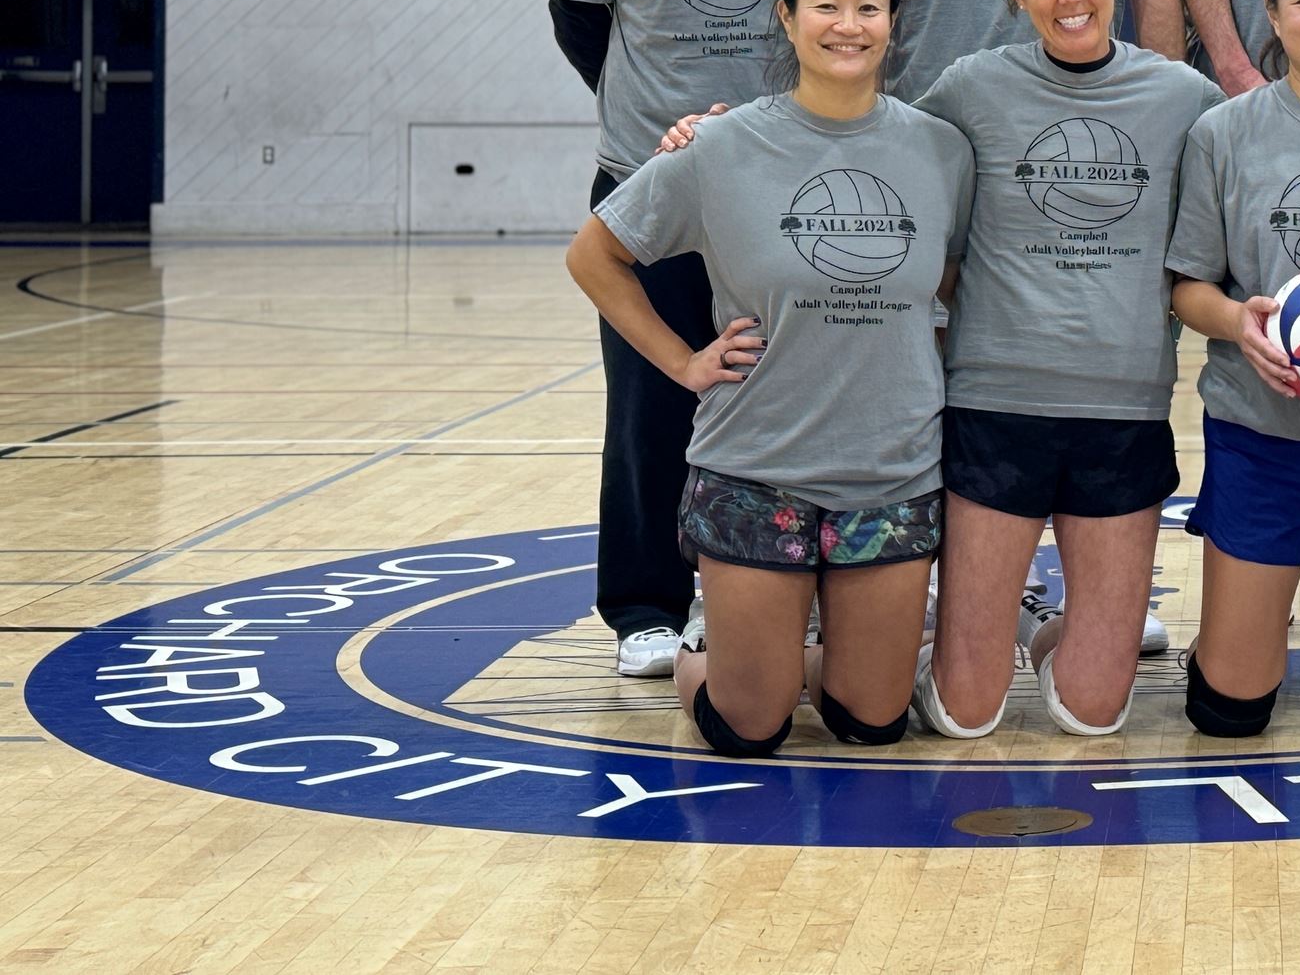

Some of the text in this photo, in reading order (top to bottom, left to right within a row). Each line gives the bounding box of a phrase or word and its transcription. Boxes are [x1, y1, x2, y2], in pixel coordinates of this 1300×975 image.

[704, 18, 748, 29] Campbell
[672, 33, 699, 42] Adult
[700, 32, 747, 43] Volleyball
[702, 45, 753, 56] Champions
[1039, 165, 1128, 181] FALL 2024
[805, 218, 895, 233] FALL 2024
[1059, 230, 1108, 243] Campbell
[1022, 244, 1141, 257] Adult Volleyball League
[1055, 259, 1112, 272] Champions
[829, 284, 882, 296] Campbell
[792, 299, 913, 313] Adult Volleyball League
[824, 314, 884, 327] Champions
[95, 553, 763, 818] ORCHARD CITY
